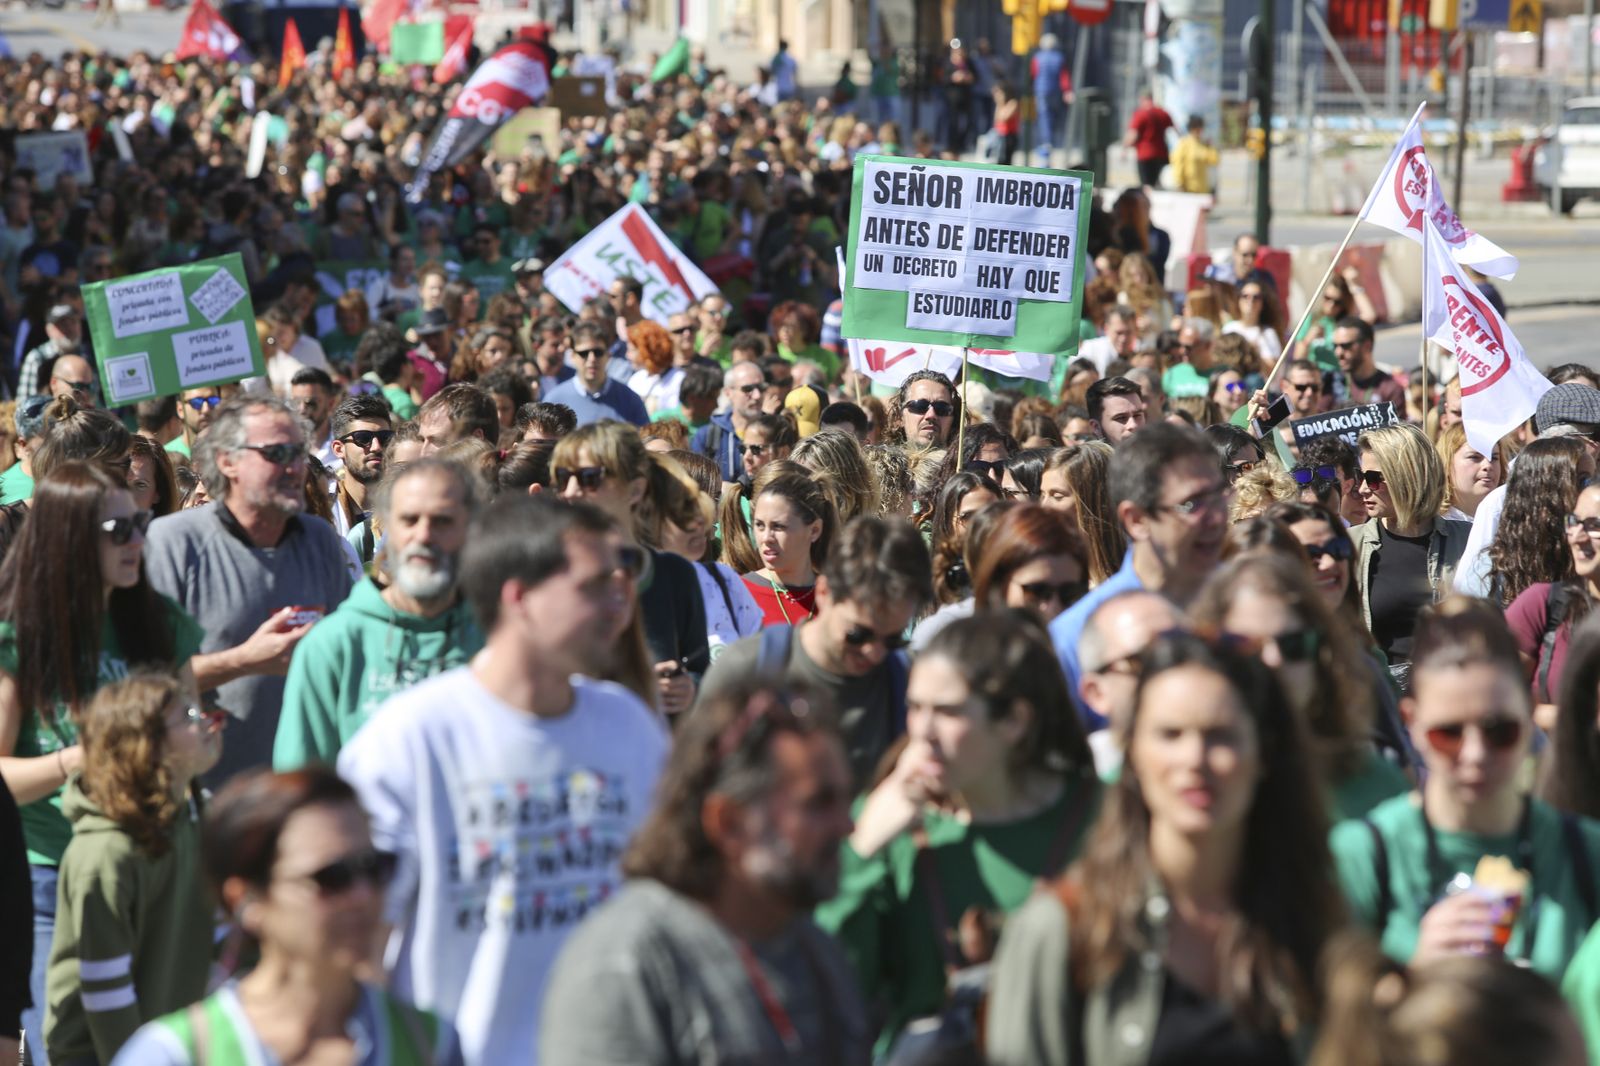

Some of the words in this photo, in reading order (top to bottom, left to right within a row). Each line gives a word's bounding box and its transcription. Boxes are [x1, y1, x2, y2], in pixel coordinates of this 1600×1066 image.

[873, 166, 963, 209] SEÑOR
[975, 177, 1075, 210] IMBRODA
[864, 216, 931, 248] ANTES
[937, 223, 964, 251] DE
[973, 227, 1070, 260] DEFENDER
[863, 253, 884, 273] UN
[893, 255, 957, 279] DECRETO
[976, 264, 1014, 290] HAY
[1024, 269, 1061, 294] QUE
[913, 292, 1012, 321] ESTUDIARLO
[1297, 407, 1373, 437] EDUCACIÓN
